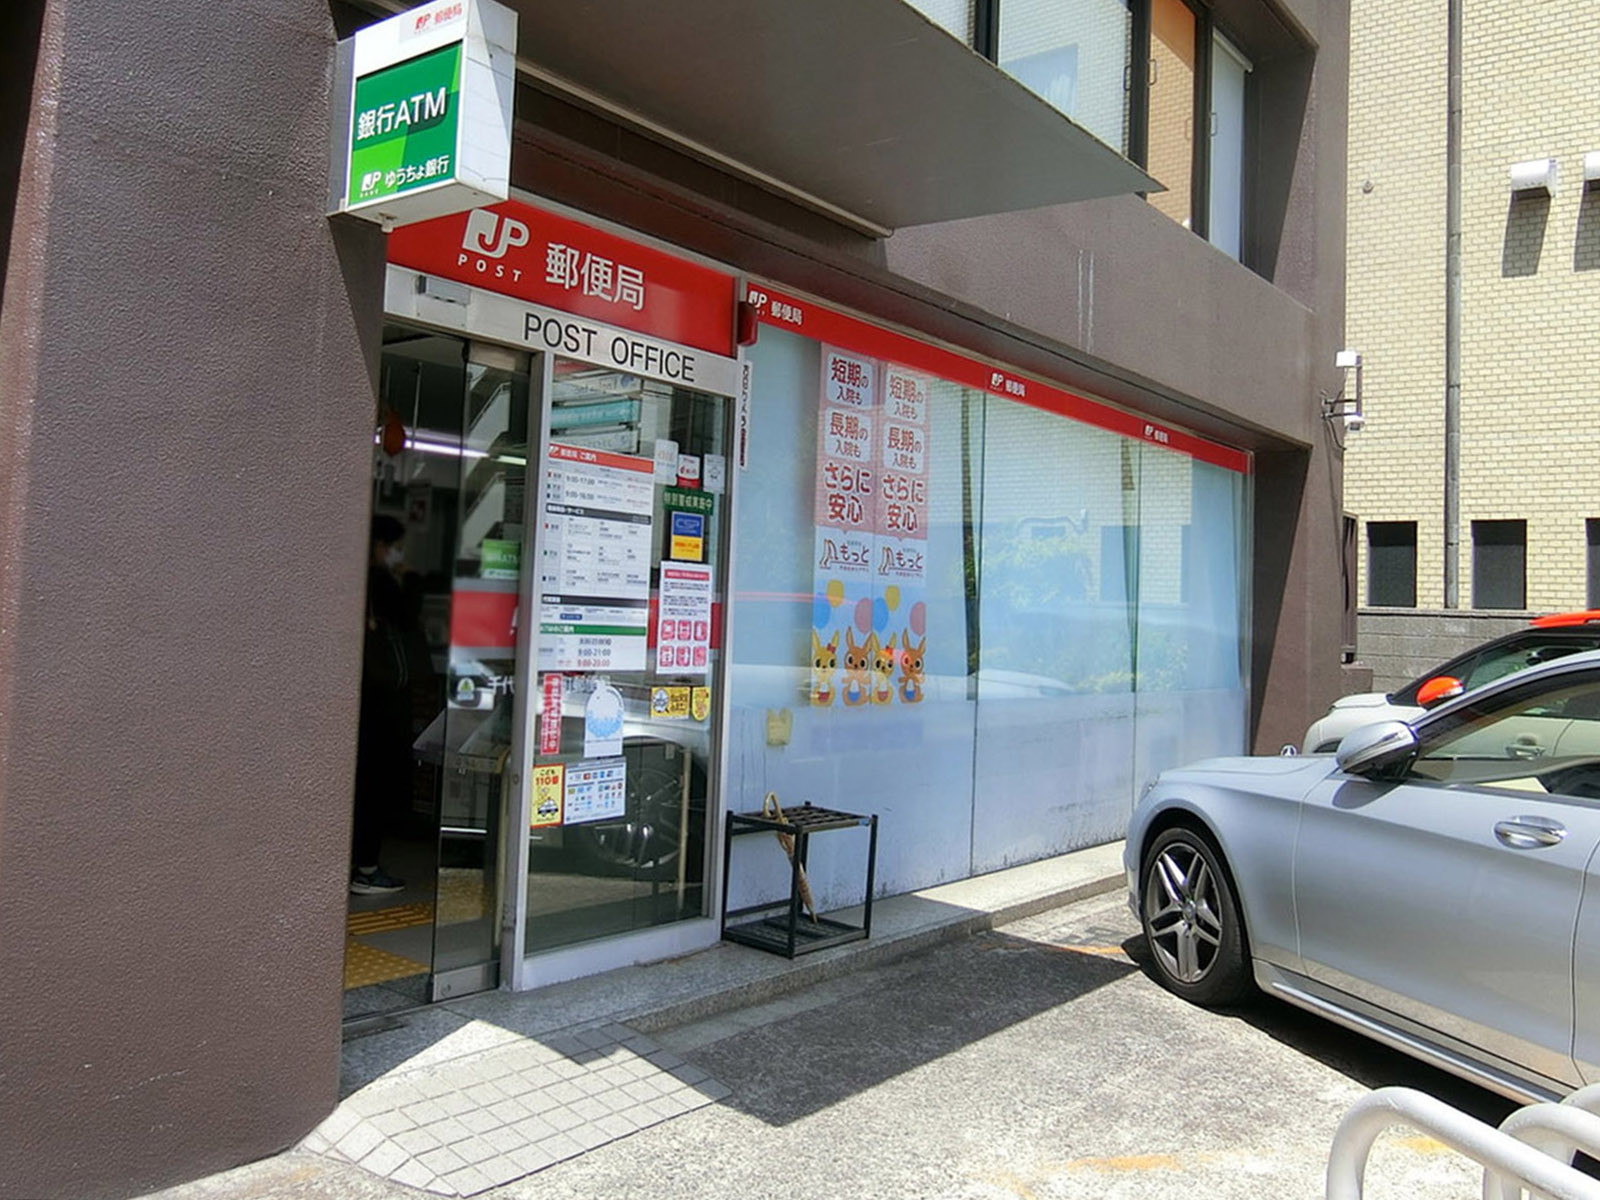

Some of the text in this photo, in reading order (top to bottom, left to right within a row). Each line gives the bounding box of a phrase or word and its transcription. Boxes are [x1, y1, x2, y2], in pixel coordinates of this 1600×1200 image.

[357, 87, 446, 140] 銀行ATM
[385, 155, 450, 188] ゆうちょ銀行
[458, 253, 522, 283] POST
[546, 242, 644, 311] 郵便局
[771, 301, 802, 326] 郵便局
[524, 312, 695, 383] POST OFFICE
[831, 357, 869, 389] 短期の
[889, 374, 923, 404] 短期の
[830, 411, 869, 441] 長期の
[887, 426, 923, 454] 長期の
[825, 462, 870, 493] さらに
[883, 474, 923, 503] さらに
[829, 493, 863, 523] 安心
[888, 503, 917, 531] 安心
[840, 543, 869, 564] もっと
[896, 549, 923, 570] もっと
